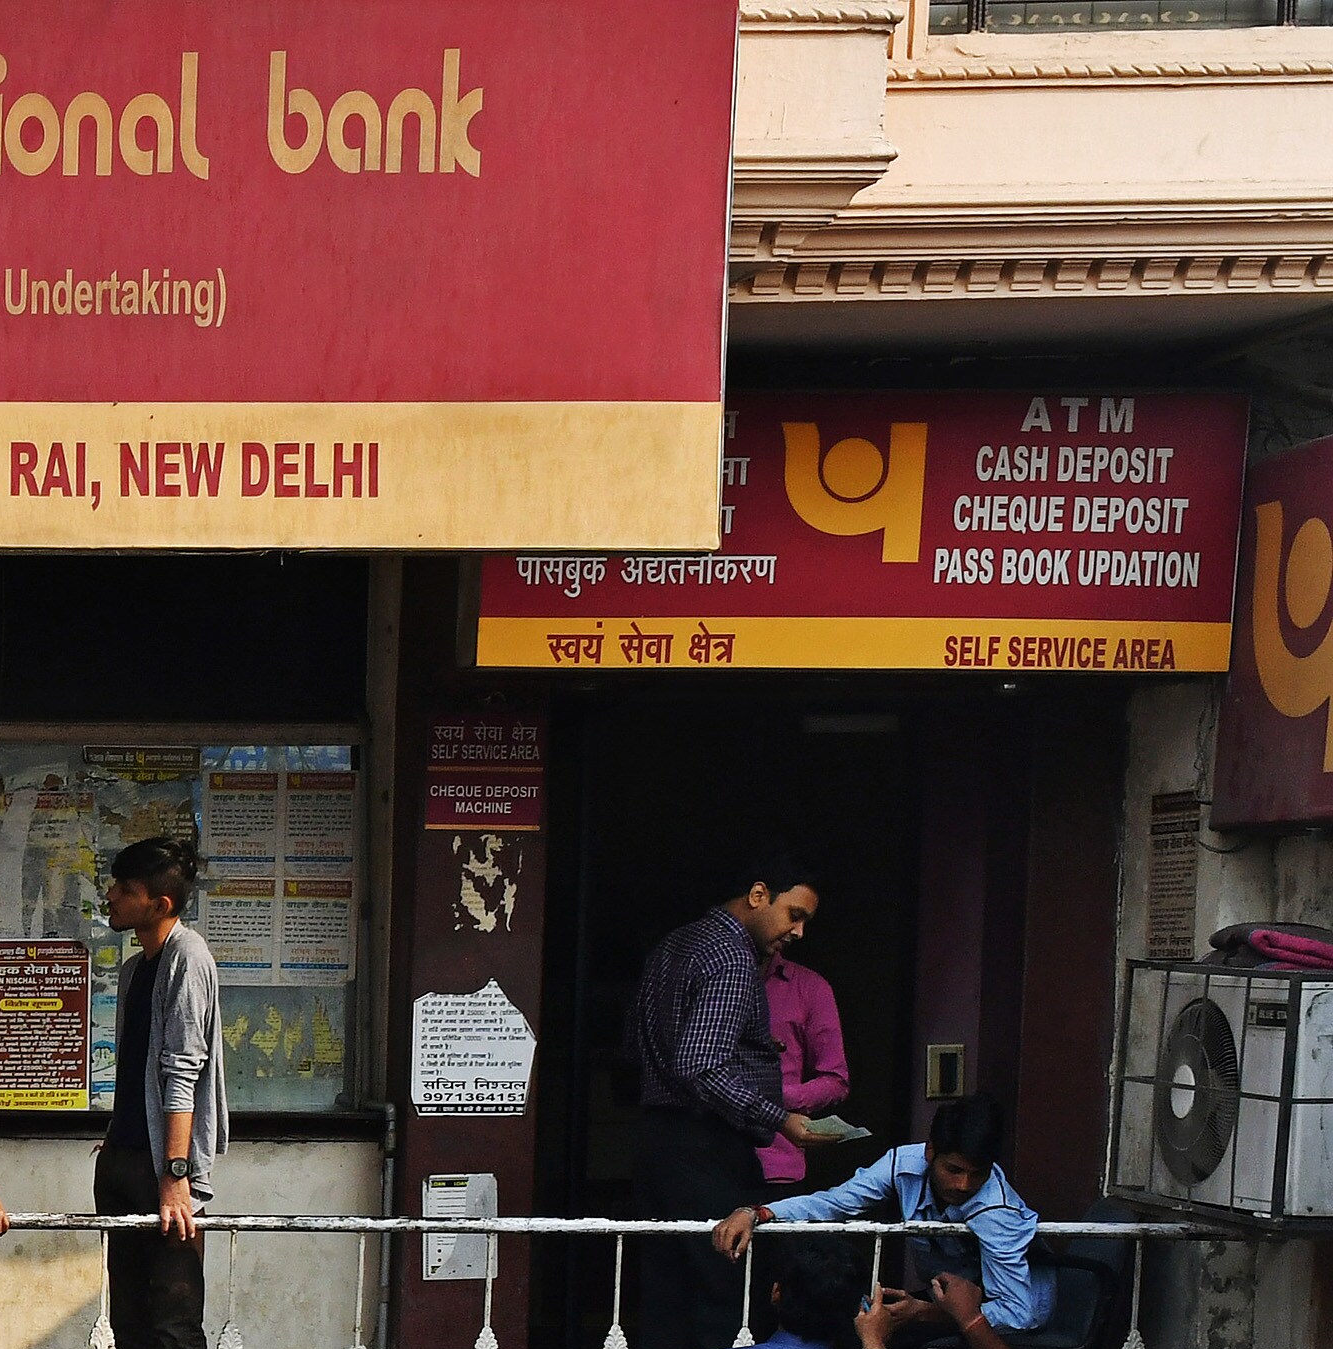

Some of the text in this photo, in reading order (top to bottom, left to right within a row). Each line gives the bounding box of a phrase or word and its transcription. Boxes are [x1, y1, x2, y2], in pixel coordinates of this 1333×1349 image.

[268, 48, 483, 178] bank
[3, 266, 227, 328] Undertaking)
[9, 440, 101, 510] RAI,
[119, 440, 228, 498] NEW
[242, 440, 381, 498] DELHI
[975, 445, 1174, 484] CASH DEPOSIT
[953, 496, 1189, 536] CHEQUE DEPOSIT
[516, 557, 607, 597] पासबुक
[934, 548, 1199, 589] PASS BOOK UPDATION
[548, 621, 735, 665] स्वयं सेवा क्षेत्र
[944, 635, 1176, 670] SELF SERVICE AREA
[434, 720, 537, 740] स्वयं सेवा क्षेत्र
[432, 744, 539, 760] SELF SERVICE AREA
[430, 785, 538, 798] CHEQUE DEPOSIT
[455, 802, 511, 813] MACHINE
[25, 964, 48, 975] सेवा
[52, 964, 81, 975] केन्द्र
[422, 1077, 527, 1090] सचिन निश्चल
[423, 1093, 525, 1102] 9971364151
